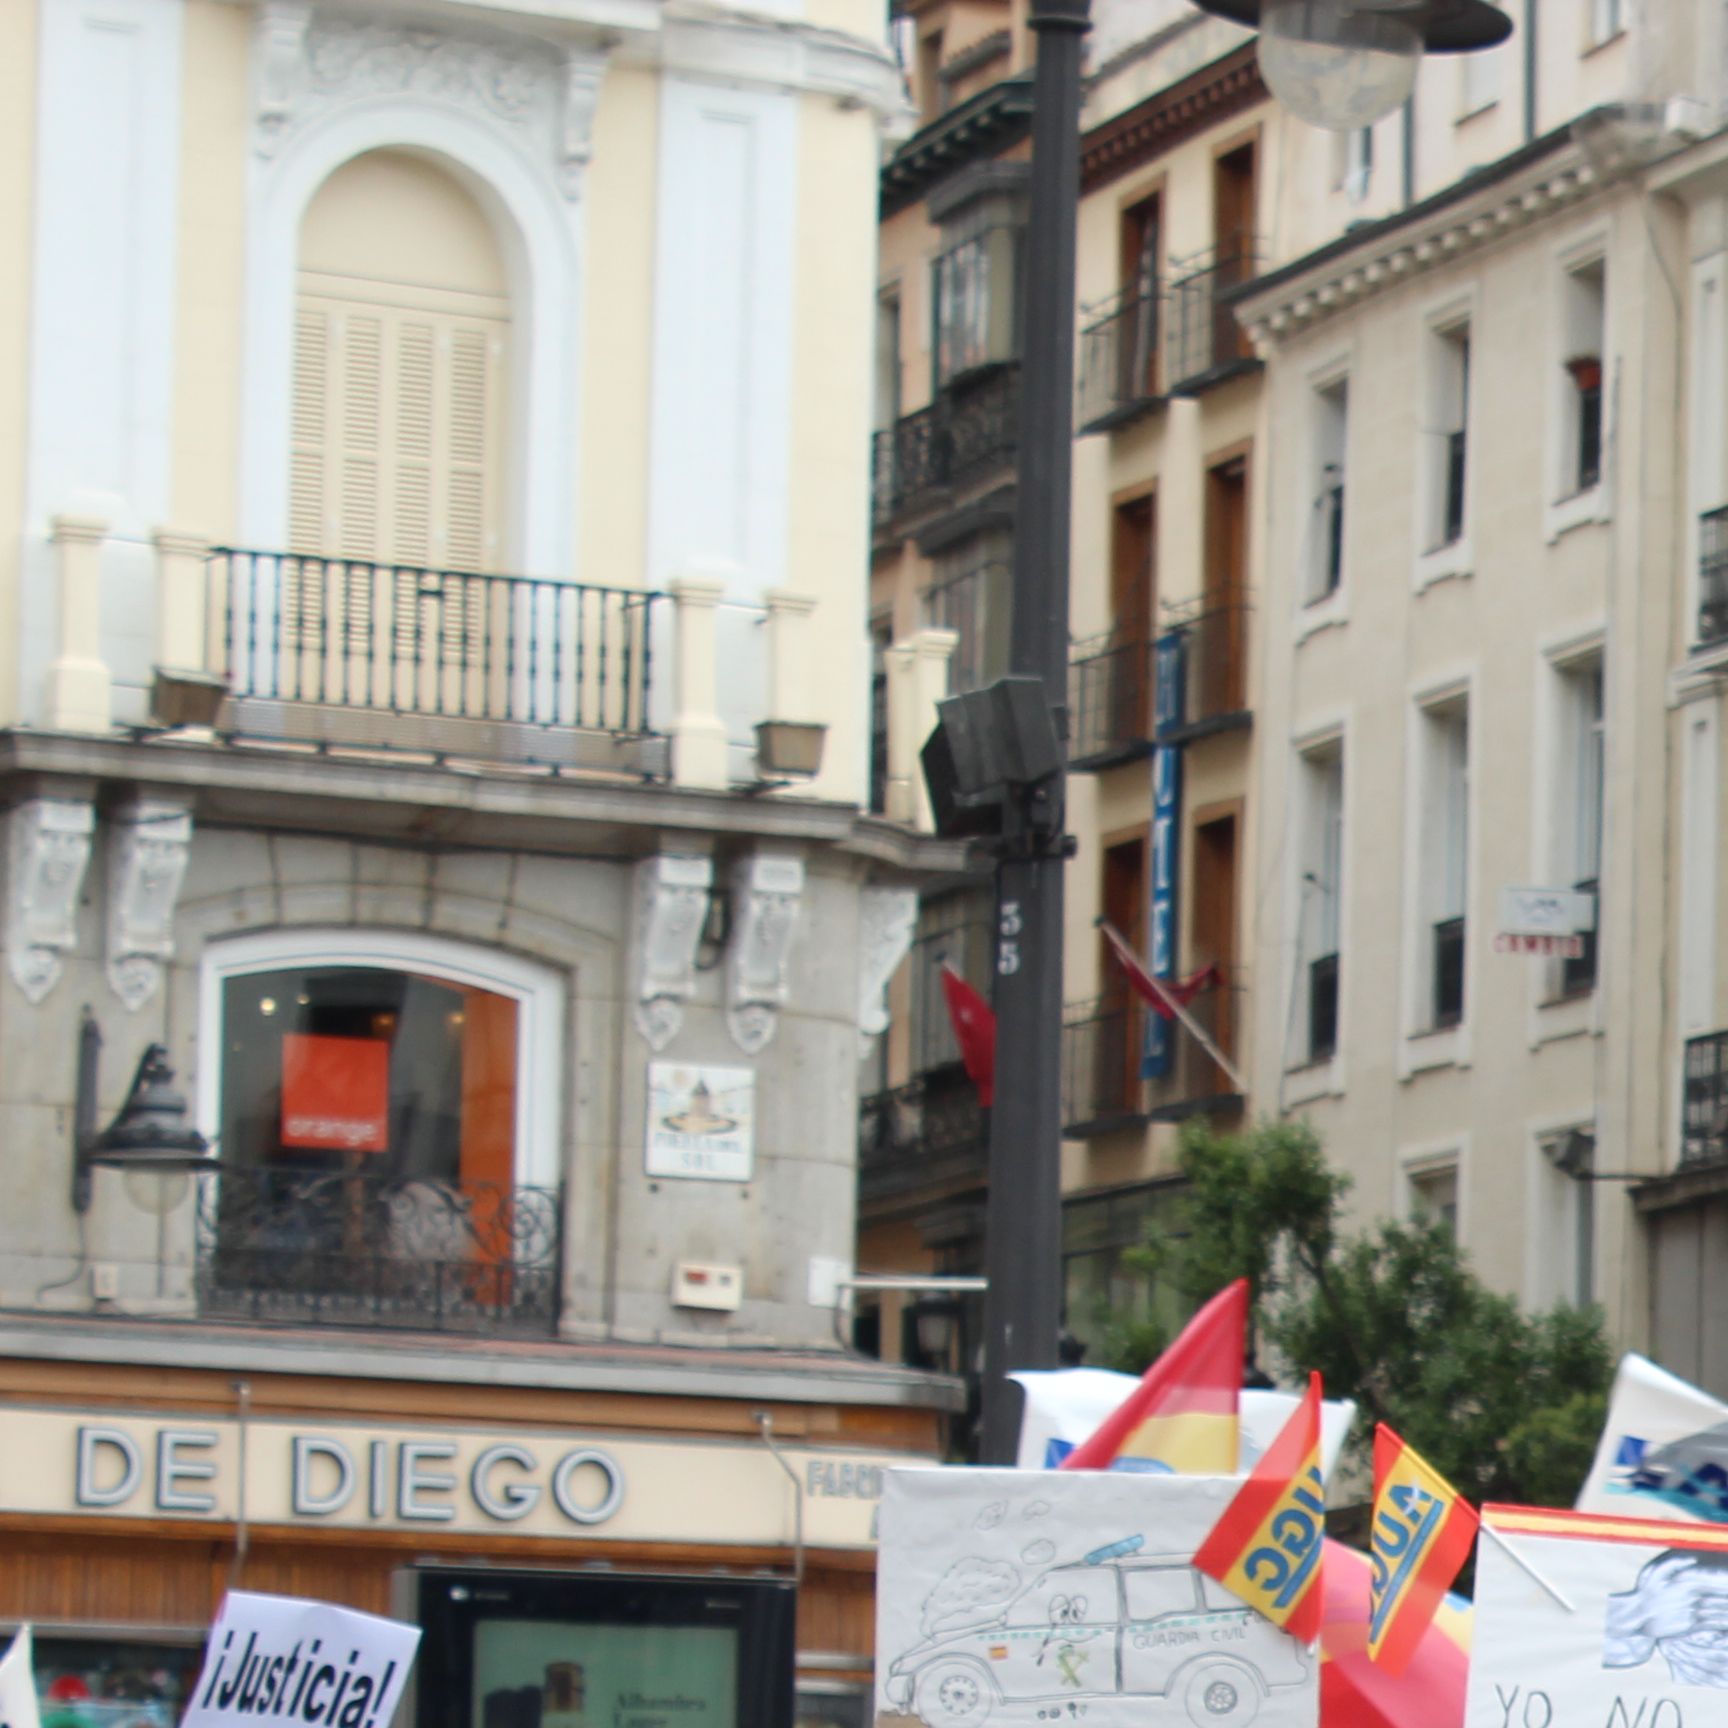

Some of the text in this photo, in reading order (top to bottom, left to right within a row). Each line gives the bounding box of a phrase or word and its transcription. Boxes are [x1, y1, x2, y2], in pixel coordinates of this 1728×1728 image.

[288, 1116, 379, 1143] orange
[76, 1426, 625, 1524] DE DIEGO
